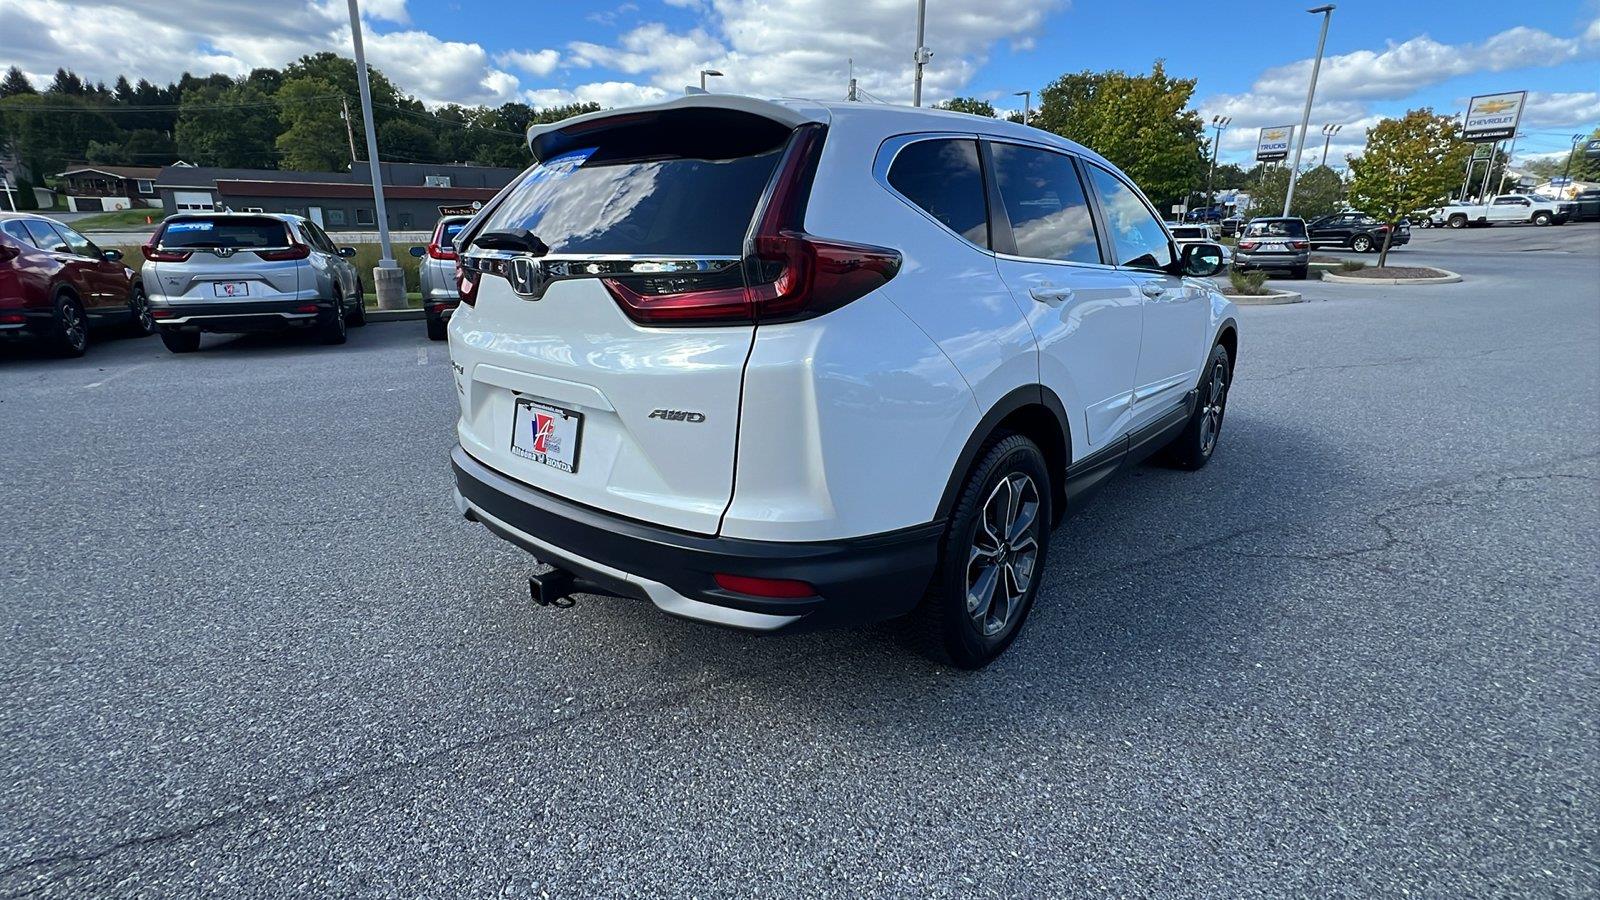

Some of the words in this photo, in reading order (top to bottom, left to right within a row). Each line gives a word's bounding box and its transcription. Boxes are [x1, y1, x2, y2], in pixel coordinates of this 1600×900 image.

[1469, 116, 1513, 127] CHEVROLET
[648, 409, 706, 423] AWD
[546, 457, 573, 473] HONDA
